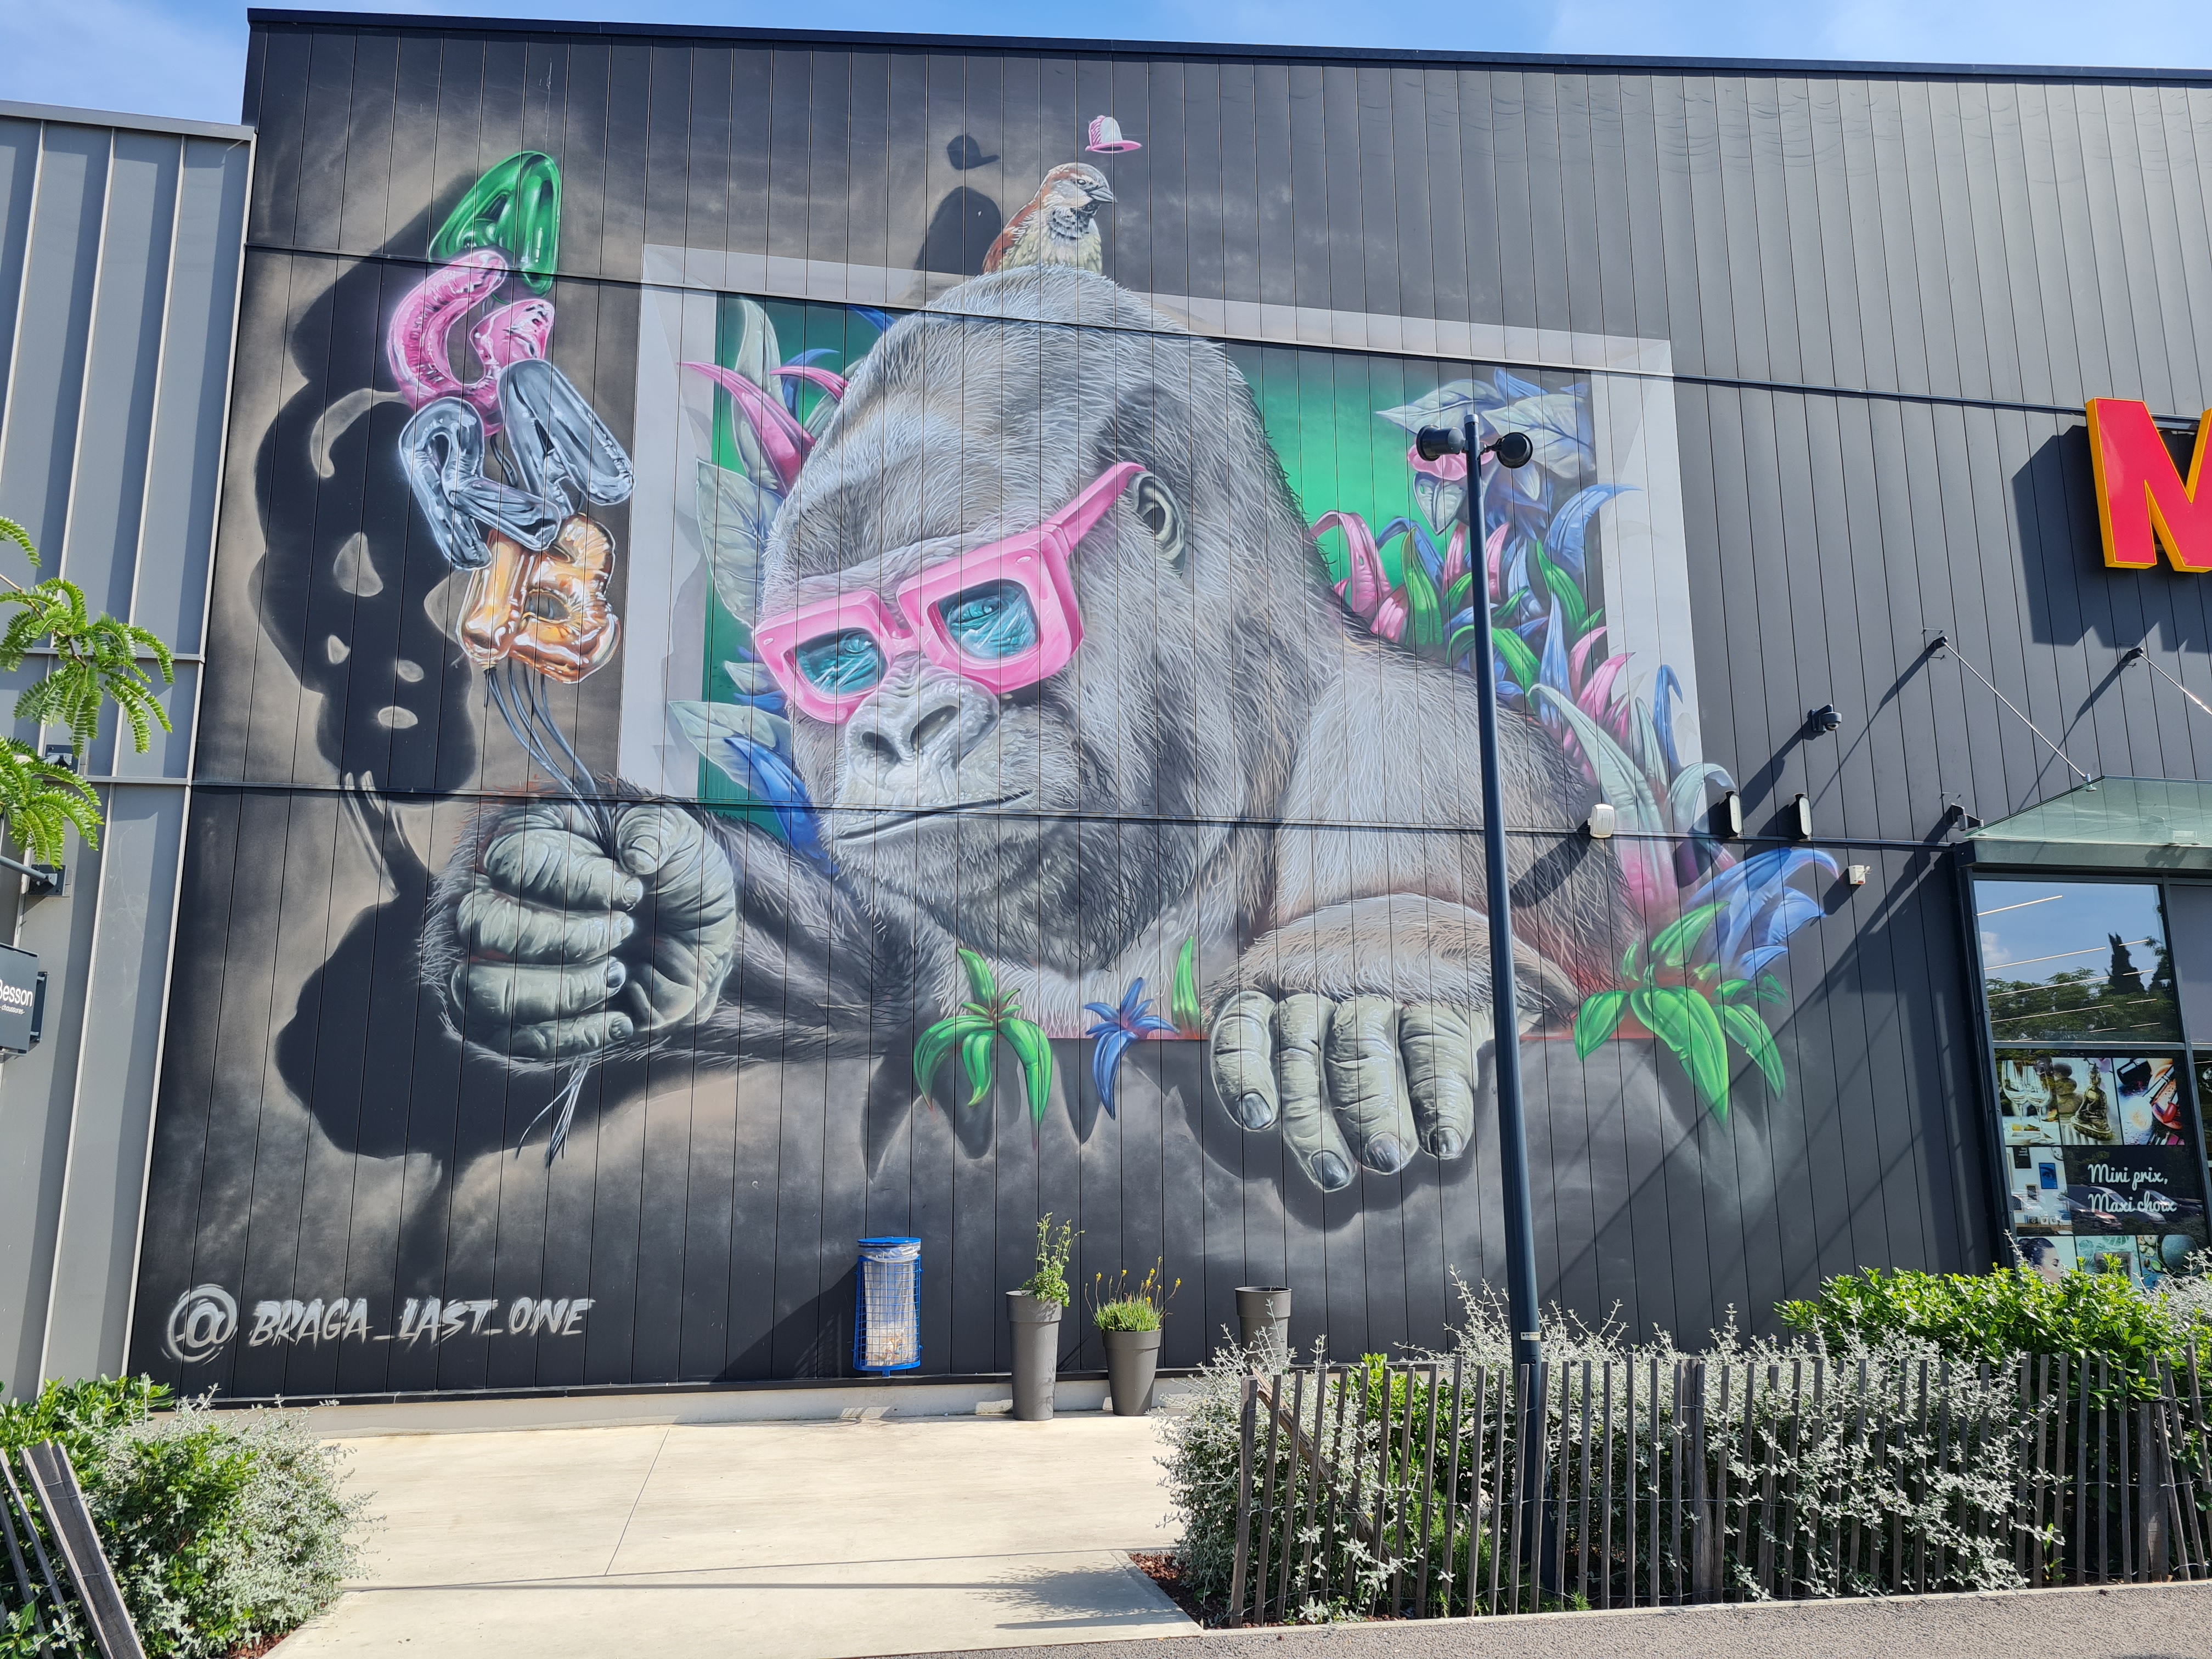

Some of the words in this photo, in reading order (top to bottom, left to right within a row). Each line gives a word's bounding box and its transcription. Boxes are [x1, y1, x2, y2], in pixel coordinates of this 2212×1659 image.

[2087, 1164, 2130, 1183] Mini
[2131, 1167, 2168, 1191] prix,
[2087, 1193, 2135, 1212] Maxi
[2137, 1190, 2177, 1212] choix
